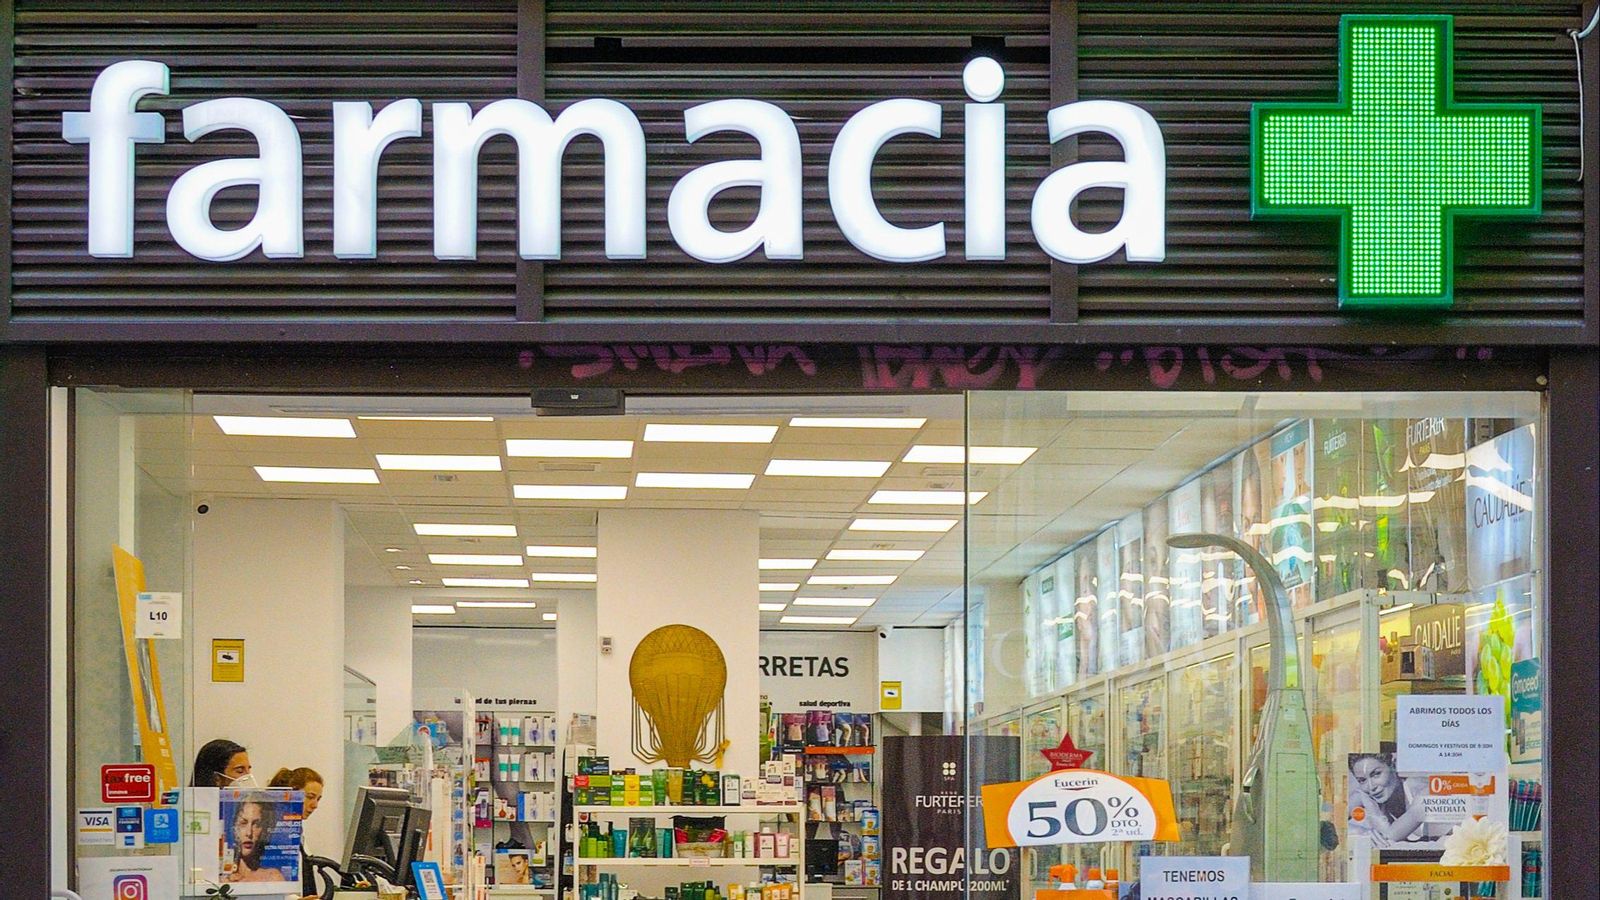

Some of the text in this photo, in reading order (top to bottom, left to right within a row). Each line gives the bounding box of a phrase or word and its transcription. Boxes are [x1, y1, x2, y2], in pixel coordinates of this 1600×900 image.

[62, 56, 1166, 264] farmacia
[149, 611, 168, 621] L10
[483, 697, 493, 705] de
[508, 697, 537, 706] piernas
[819, 700, 851, 708] deportiva
[1409, 707, 1492, 715] ABRIMOS TODOS LOS
[1441, 719, 1460, 728] DÍAS
[1054, 777, 1099, 788] Eucerin
[1430, 777, 1452, 793] 0%
[1424, 805, 1466, 813] INMEDIATA
[84, 816, 109, 826] VISA
[891, 847, 1011, 875] REGALO
[1163, 870, 1225, 882] TENEMOS
[892, 880, 905, 891] DE
[906, 880, 913, 891] 1
